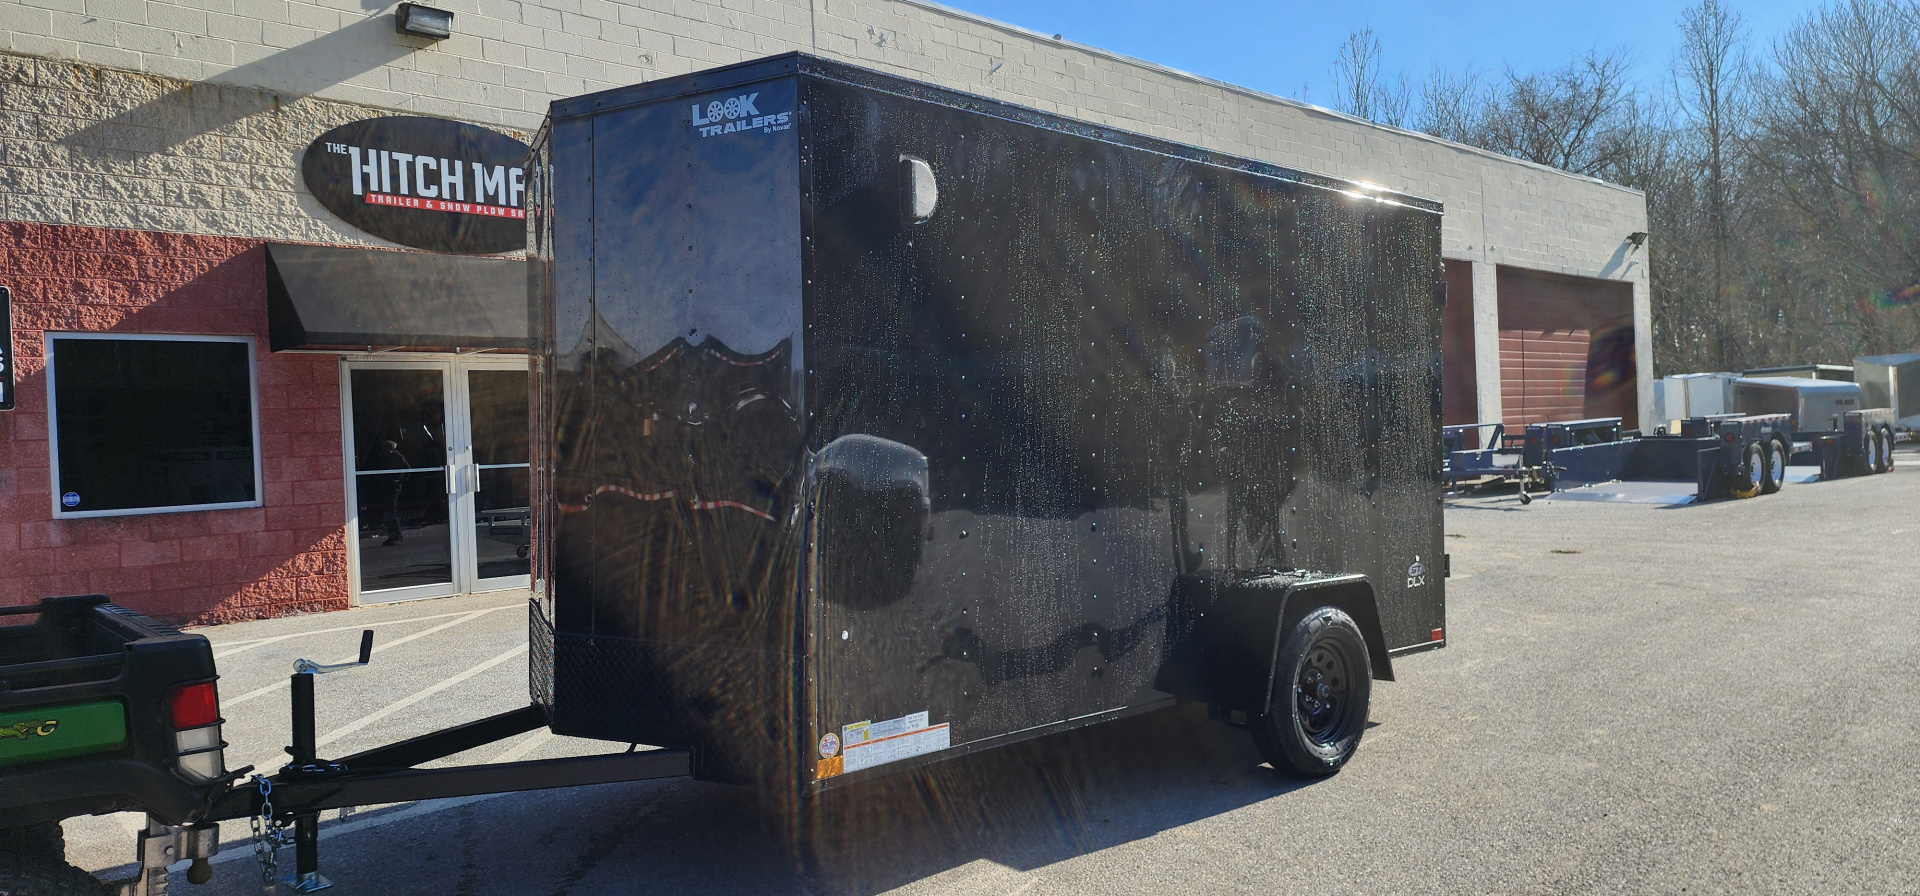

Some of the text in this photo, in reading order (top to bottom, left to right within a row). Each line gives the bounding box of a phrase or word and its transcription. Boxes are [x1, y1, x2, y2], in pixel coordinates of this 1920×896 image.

[692, 92, 760, 126] LOOK
[325, 142, 348, 155] THE
[348, 146, 465, 201] HITCH
[370, 194, 420, 207] TRAILER
[426, 199, 434, 209] &
[440, 202, 471, 213] SNOW
[476, 205, 506, 216] PLOW
[1407, 575, 1425, 588] DLX
